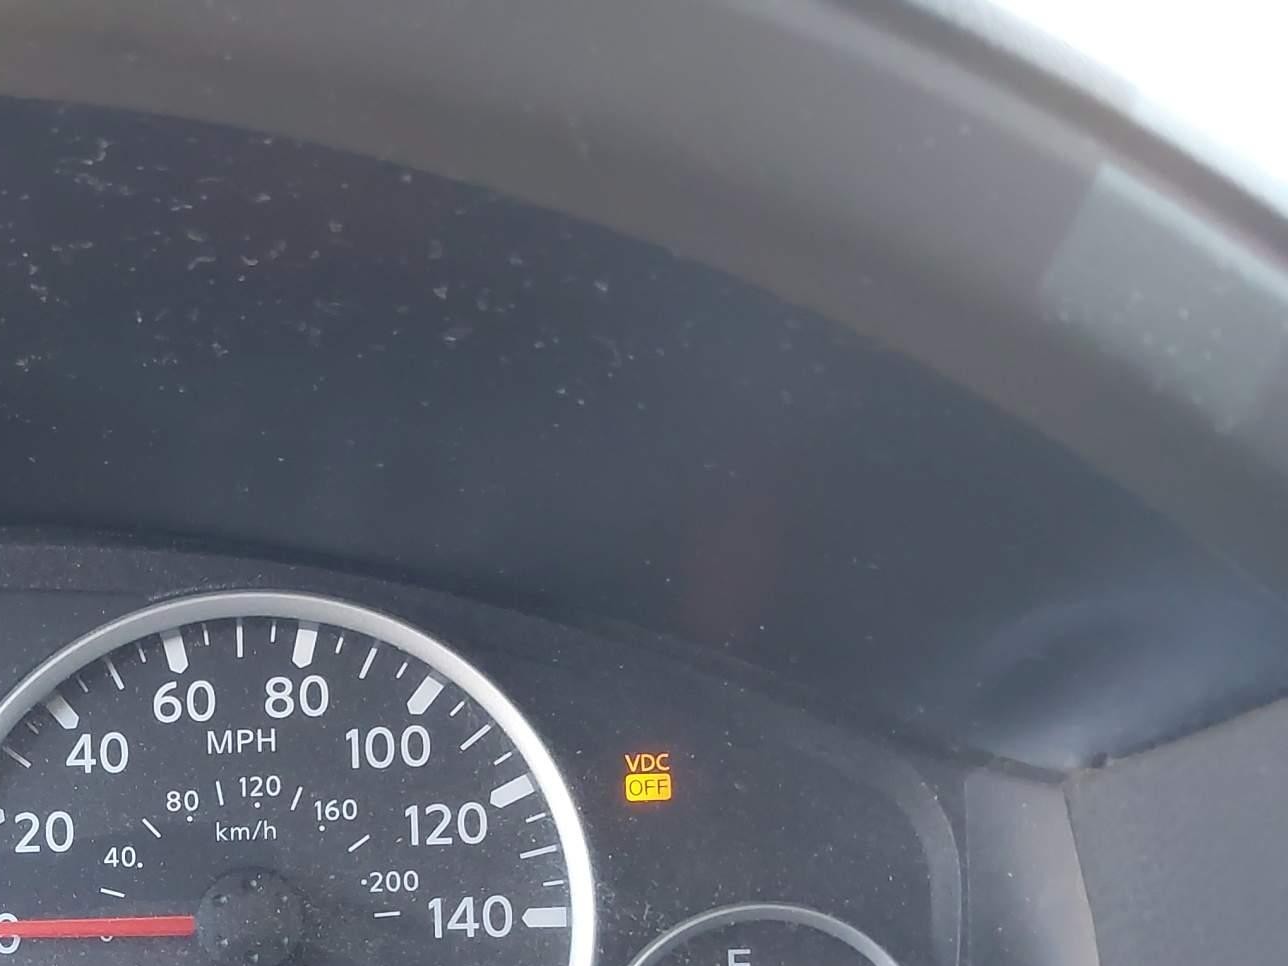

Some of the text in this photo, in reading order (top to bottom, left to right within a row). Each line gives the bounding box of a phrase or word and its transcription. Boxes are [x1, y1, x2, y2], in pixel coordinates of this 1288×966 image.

[153, 680, 216, 722] 60
[264, 676, 329, 718] 80
[66, 732, 129, 774] 40
[207, 729, 278, 755] MPH
[345, 726, 431, 768] 100
[624, 753, 670, 772] VDC
[239, 775, 281, 798] 120
[629, 779, 669, 796] OFF
[166, 791, 200, 813] 80
[314, 799, 358, 821] 160
[14, 811, 74, 853] 20
[215, 820, 278, 843] km/h
[405, 802, 487, 845] 120
[369, 871, 418, 893] 200
[428, 895, 513, 939] 140
